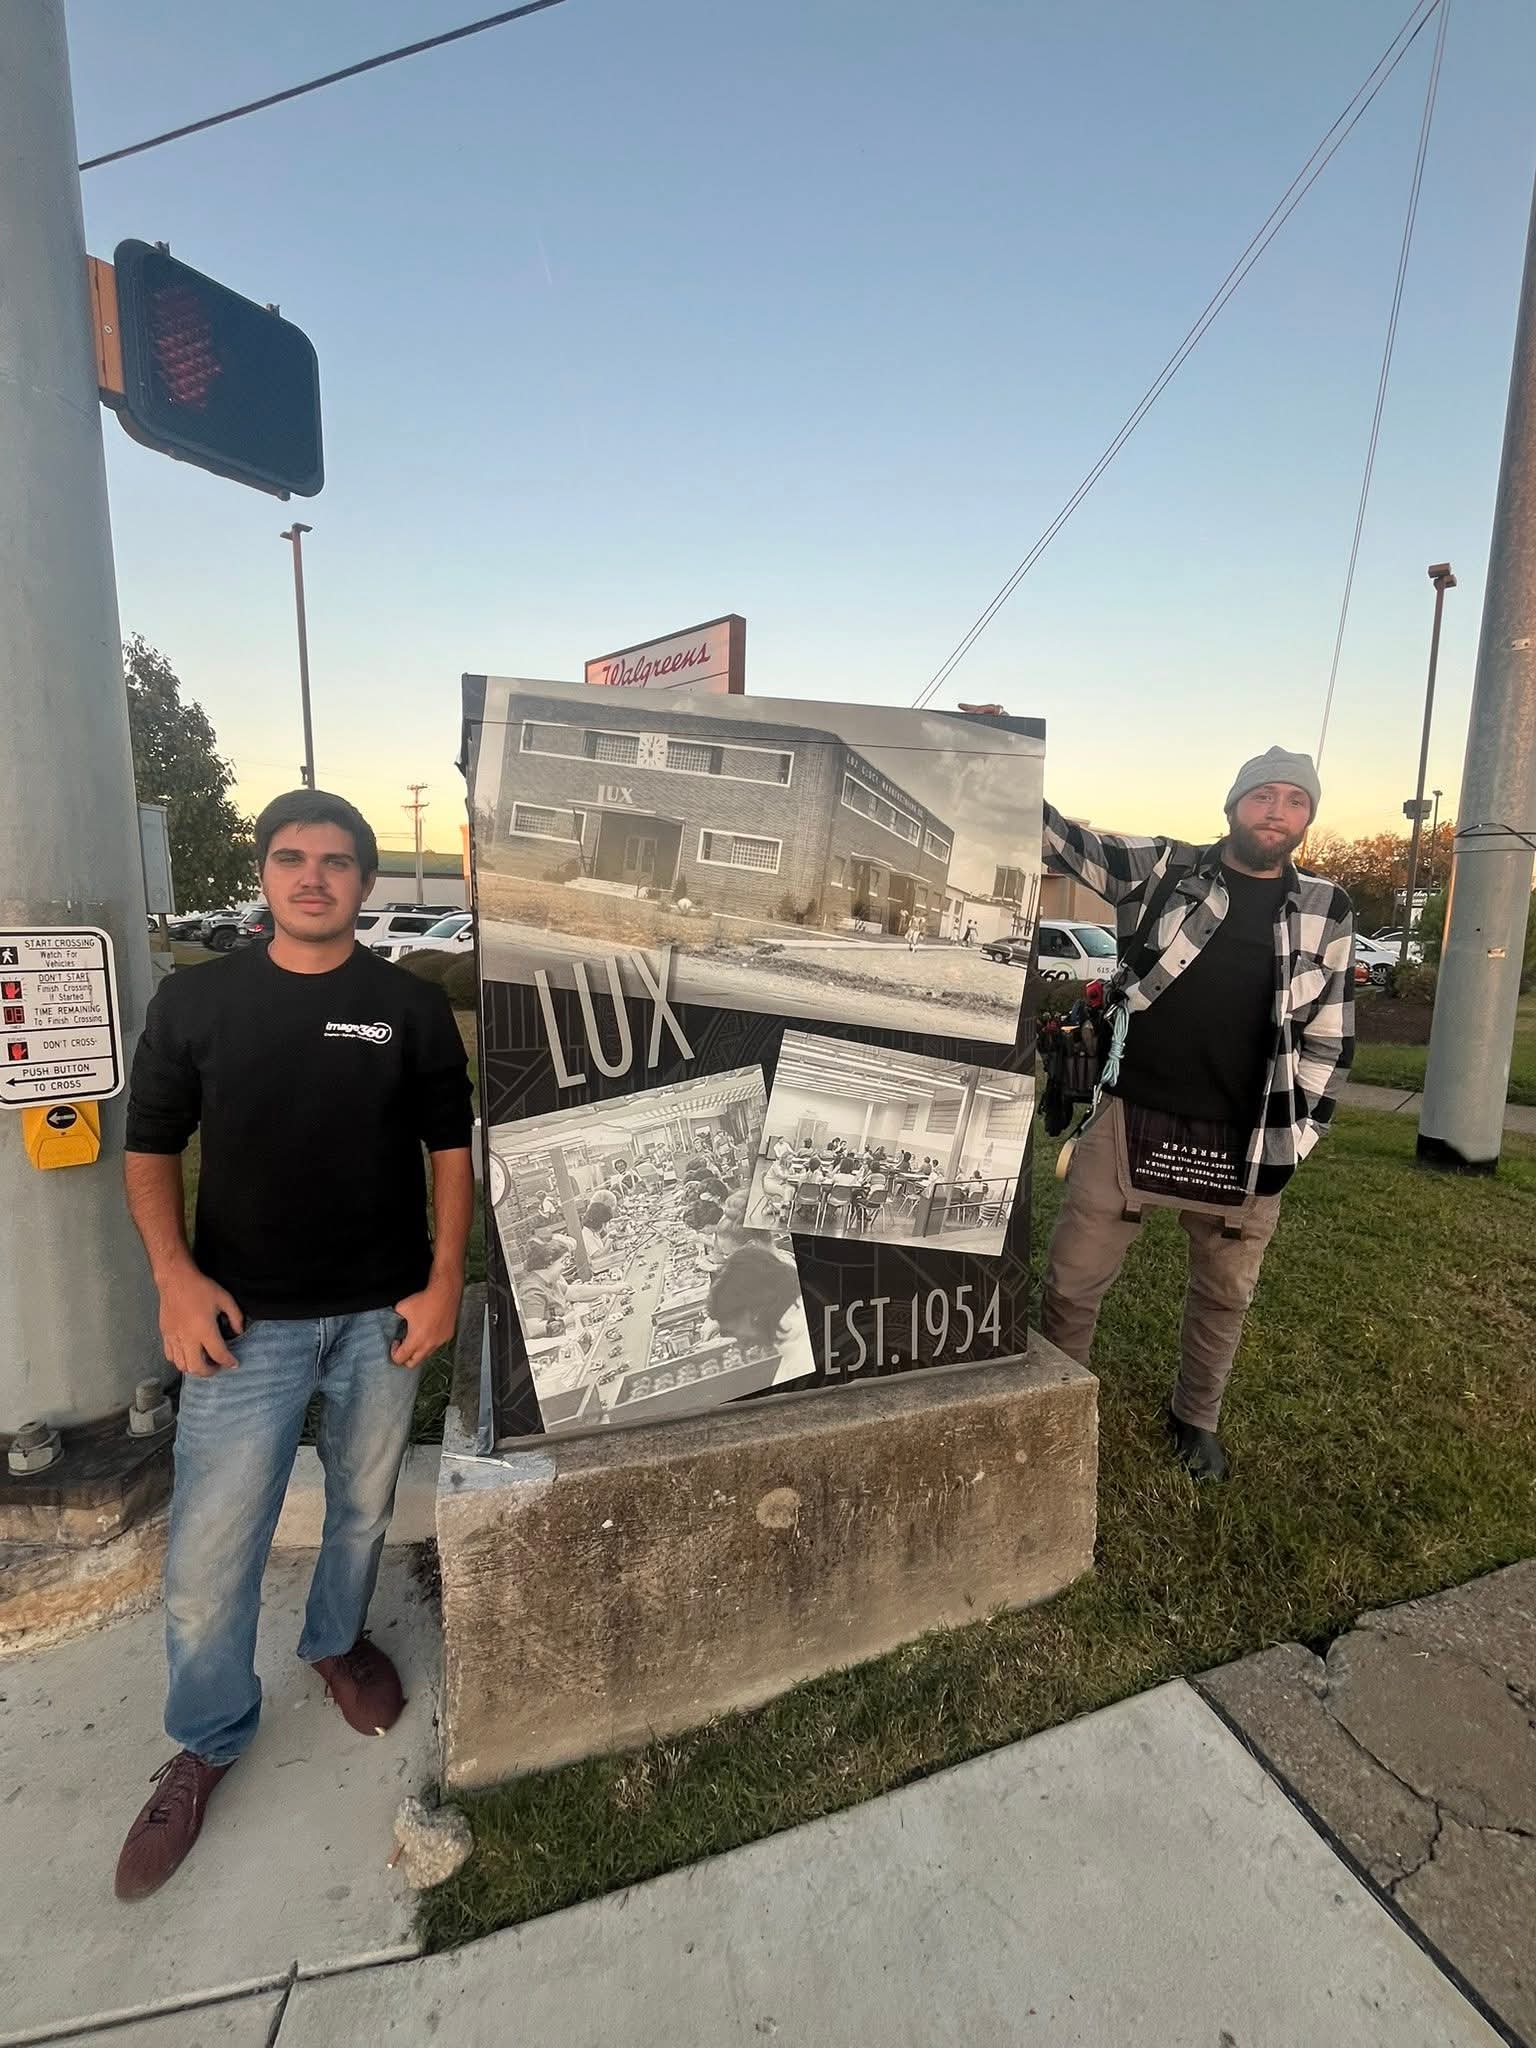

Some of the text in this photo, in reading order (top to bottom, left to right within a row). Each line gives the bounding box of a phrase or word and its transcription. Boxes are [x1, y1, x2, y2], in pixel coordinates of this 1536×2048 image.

[602, 643, 711, 688] Walgreens
[25, 938, 95, 948] START CROSSING
[45, 960, 75, 968] Vehicles
[38, 973, 89, 982] DON'T START
[37, 983, 92, 993] Finish Crossing
[59, 993, 84, 1001] Started
[58, 1005, 101, 1014] REMAINING
[74, 1015, 103, 1024] Crossing
[534, 945, 695, 1088] LUX
[43, 1040, 66, 1049] DON'T
[22, 1064, 90, 1077] PUSH BUTTON
[34, 1080, 81, 1092] TO CROSS
[824, 1281, 1001, 1375] EST. 1954
